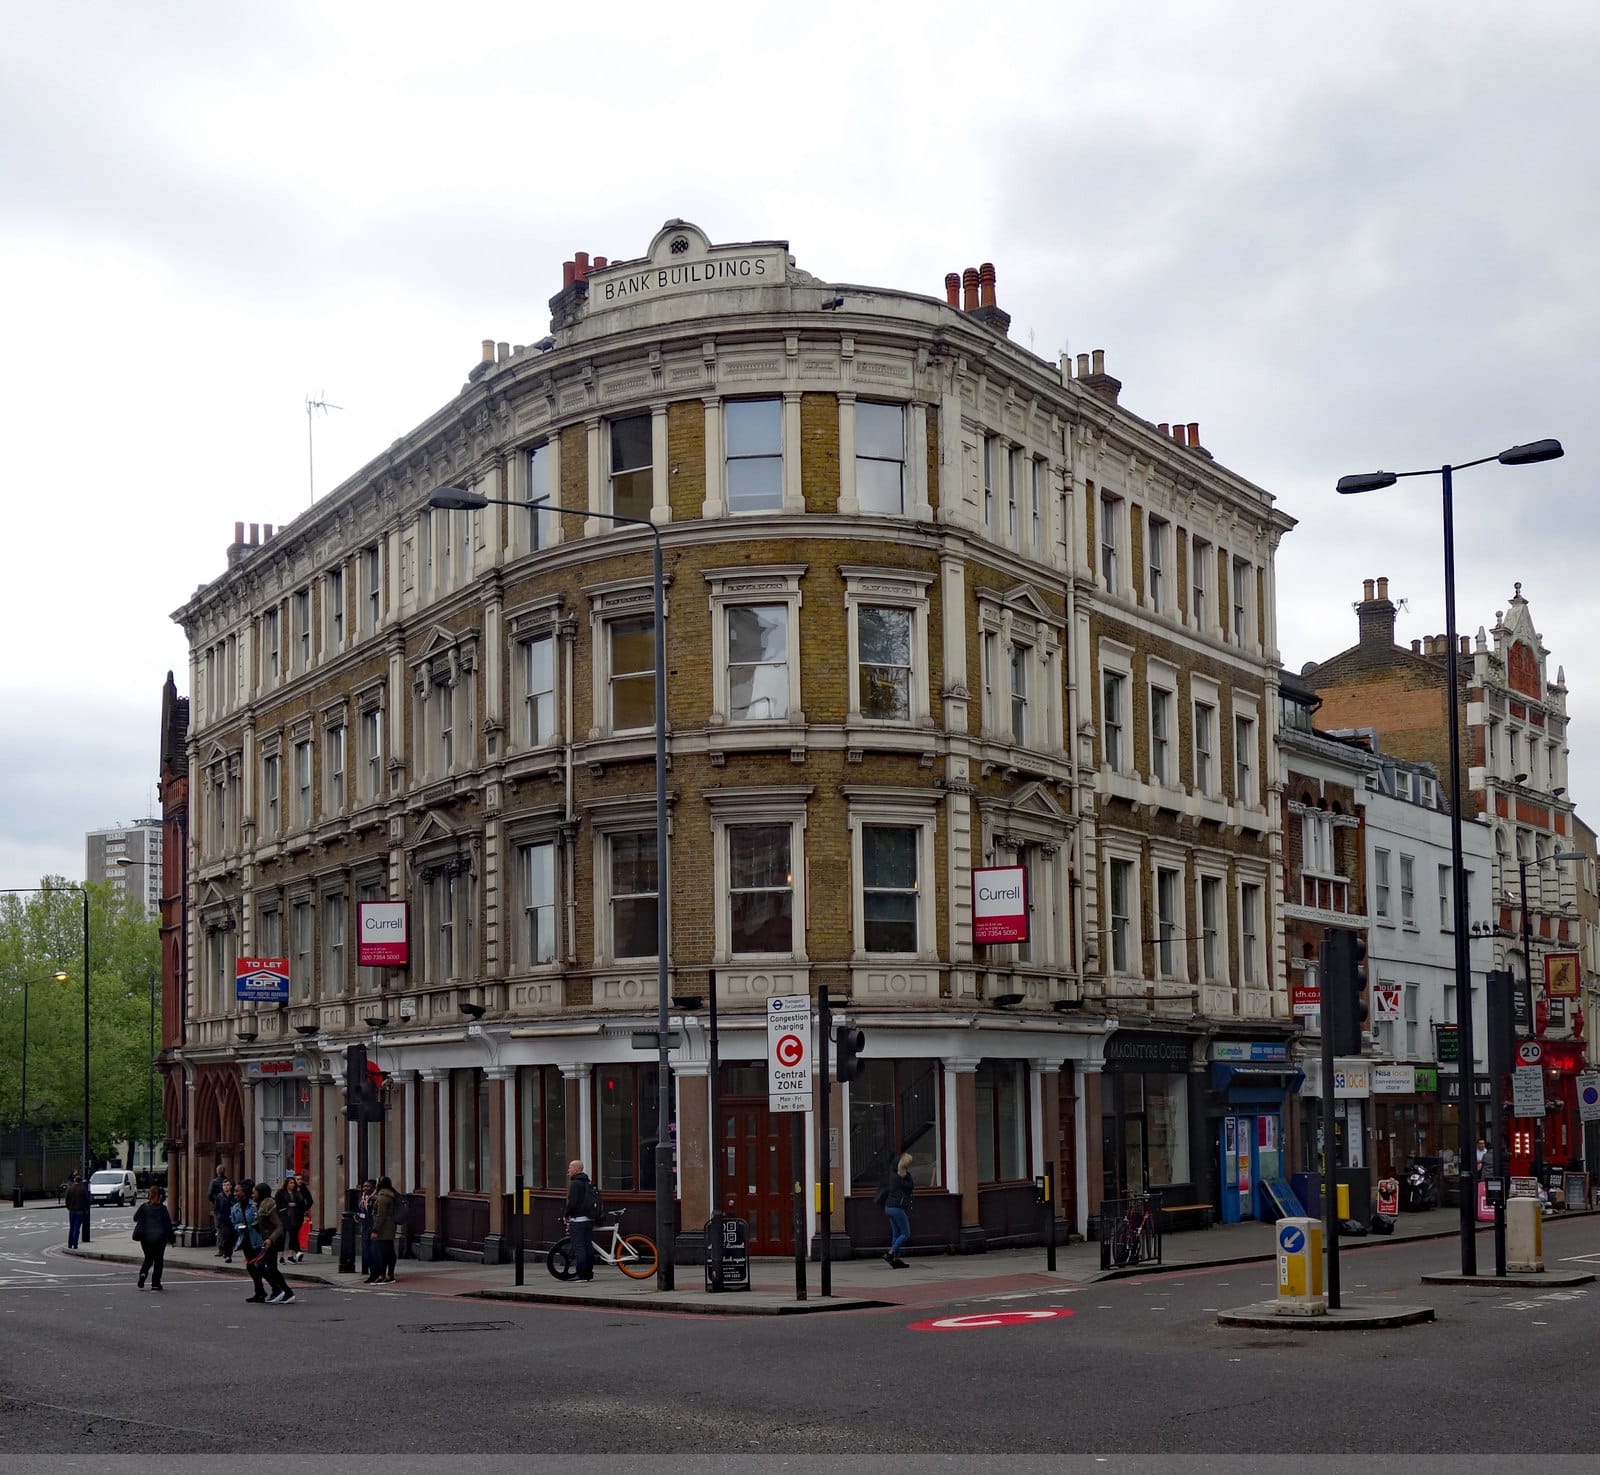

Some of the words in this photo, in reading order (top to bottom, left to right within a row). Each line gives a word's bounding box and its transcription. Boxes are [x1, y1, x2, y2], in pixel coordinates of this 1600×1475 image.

[605, 276, 650, 300] BANK
[658, 259, 766, 288] BUILDINGS
[979, 886, 1020, 901] Currell
[366, 917, 403, 930] Currell
[263, 961, 282, 969] LET
[245, 979, 281, 987] LOFT
[770, 1013, 808, 1023] Congestion
[774, 1022, 804, 1031] charging
[1159, 1042, 1188, 1060] COFFEE
[1522, 1046, 1540, 1057] 20
[774, 1070, 806, 1080] Central
[777, 1081, 803, 1090] ZONE
[1347, 1072, 1366, 1089] local
